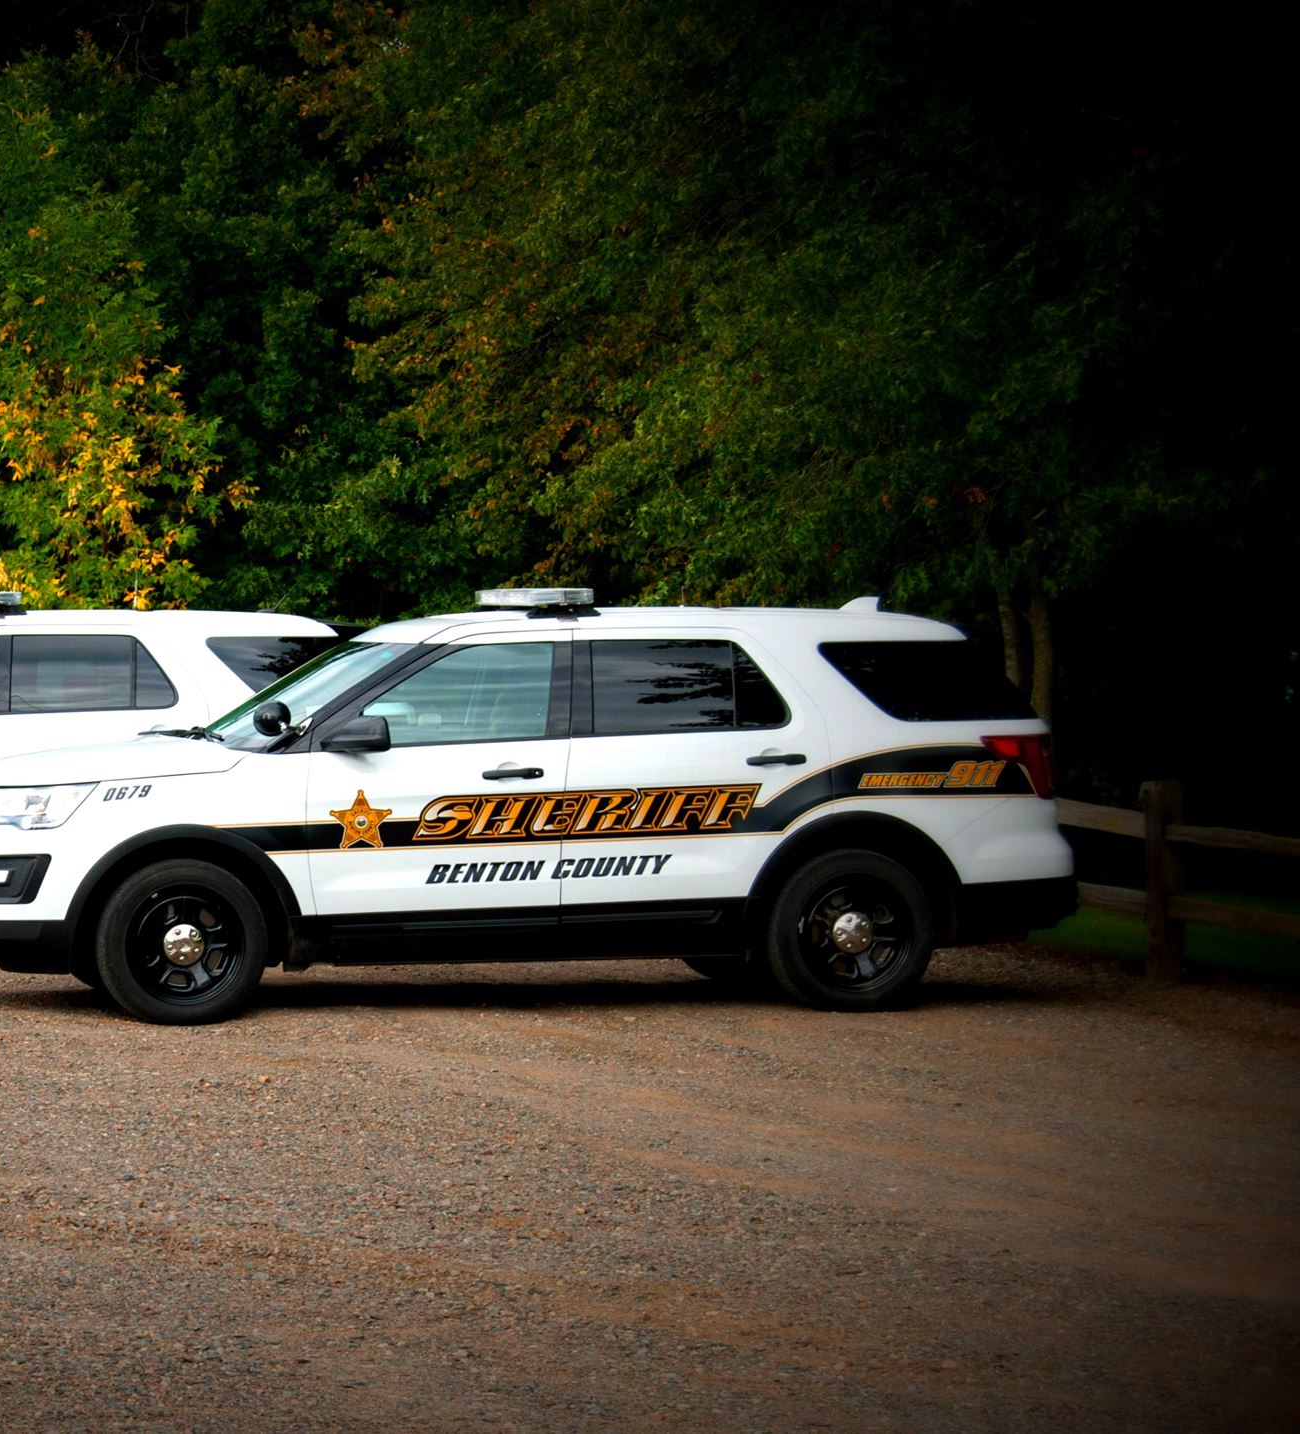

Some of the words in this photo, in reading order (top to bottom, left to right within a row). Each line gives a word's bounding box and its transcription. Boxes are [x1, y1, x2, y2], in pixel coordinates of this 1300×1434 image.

[858, 772, 948, 789] EMERGENCY
[943, 760, 1006, 788] 911
[103, 784, 152, 801] 0679
[412, 783, 762, 841] SHERIFF
[425, 860, 544, 884] BENTON
[551, 854, 672, 880] COUNTY
